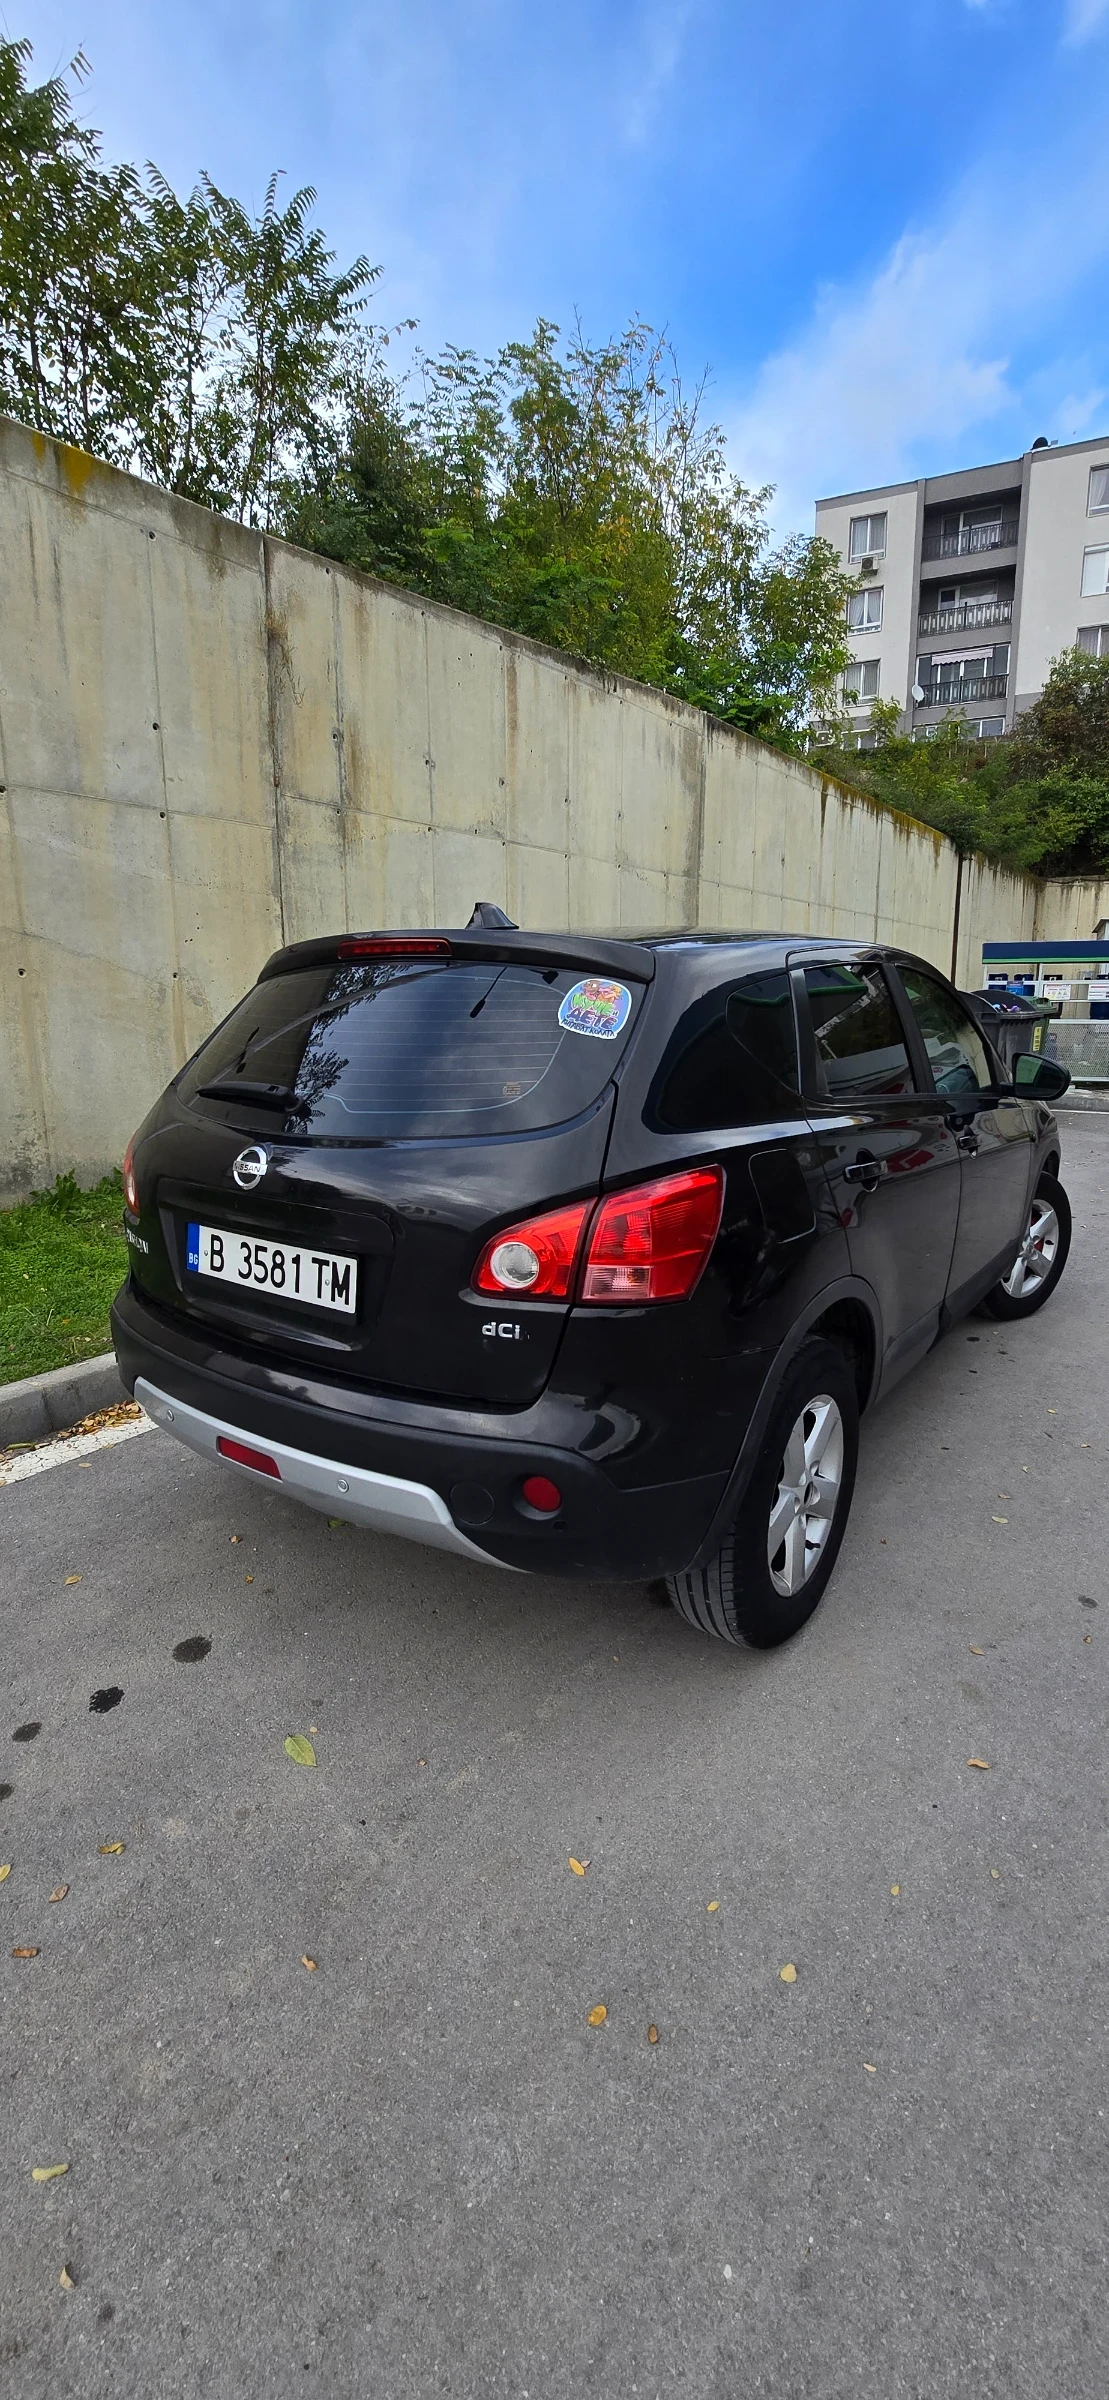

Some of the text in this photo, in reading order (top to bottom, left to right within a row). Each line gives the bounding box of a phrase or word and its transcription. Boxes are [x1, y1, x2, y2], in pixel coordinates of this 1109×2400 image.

[566, 1006, 617, 1029] ДЕТЕ
[235, 1162, 261, 1173] NISSAN
[188, 1252, 199, 1265] BG
[210, 1234, 351, 1306] B 3581 TM
[482, 1321, 520, 1340] dCi
